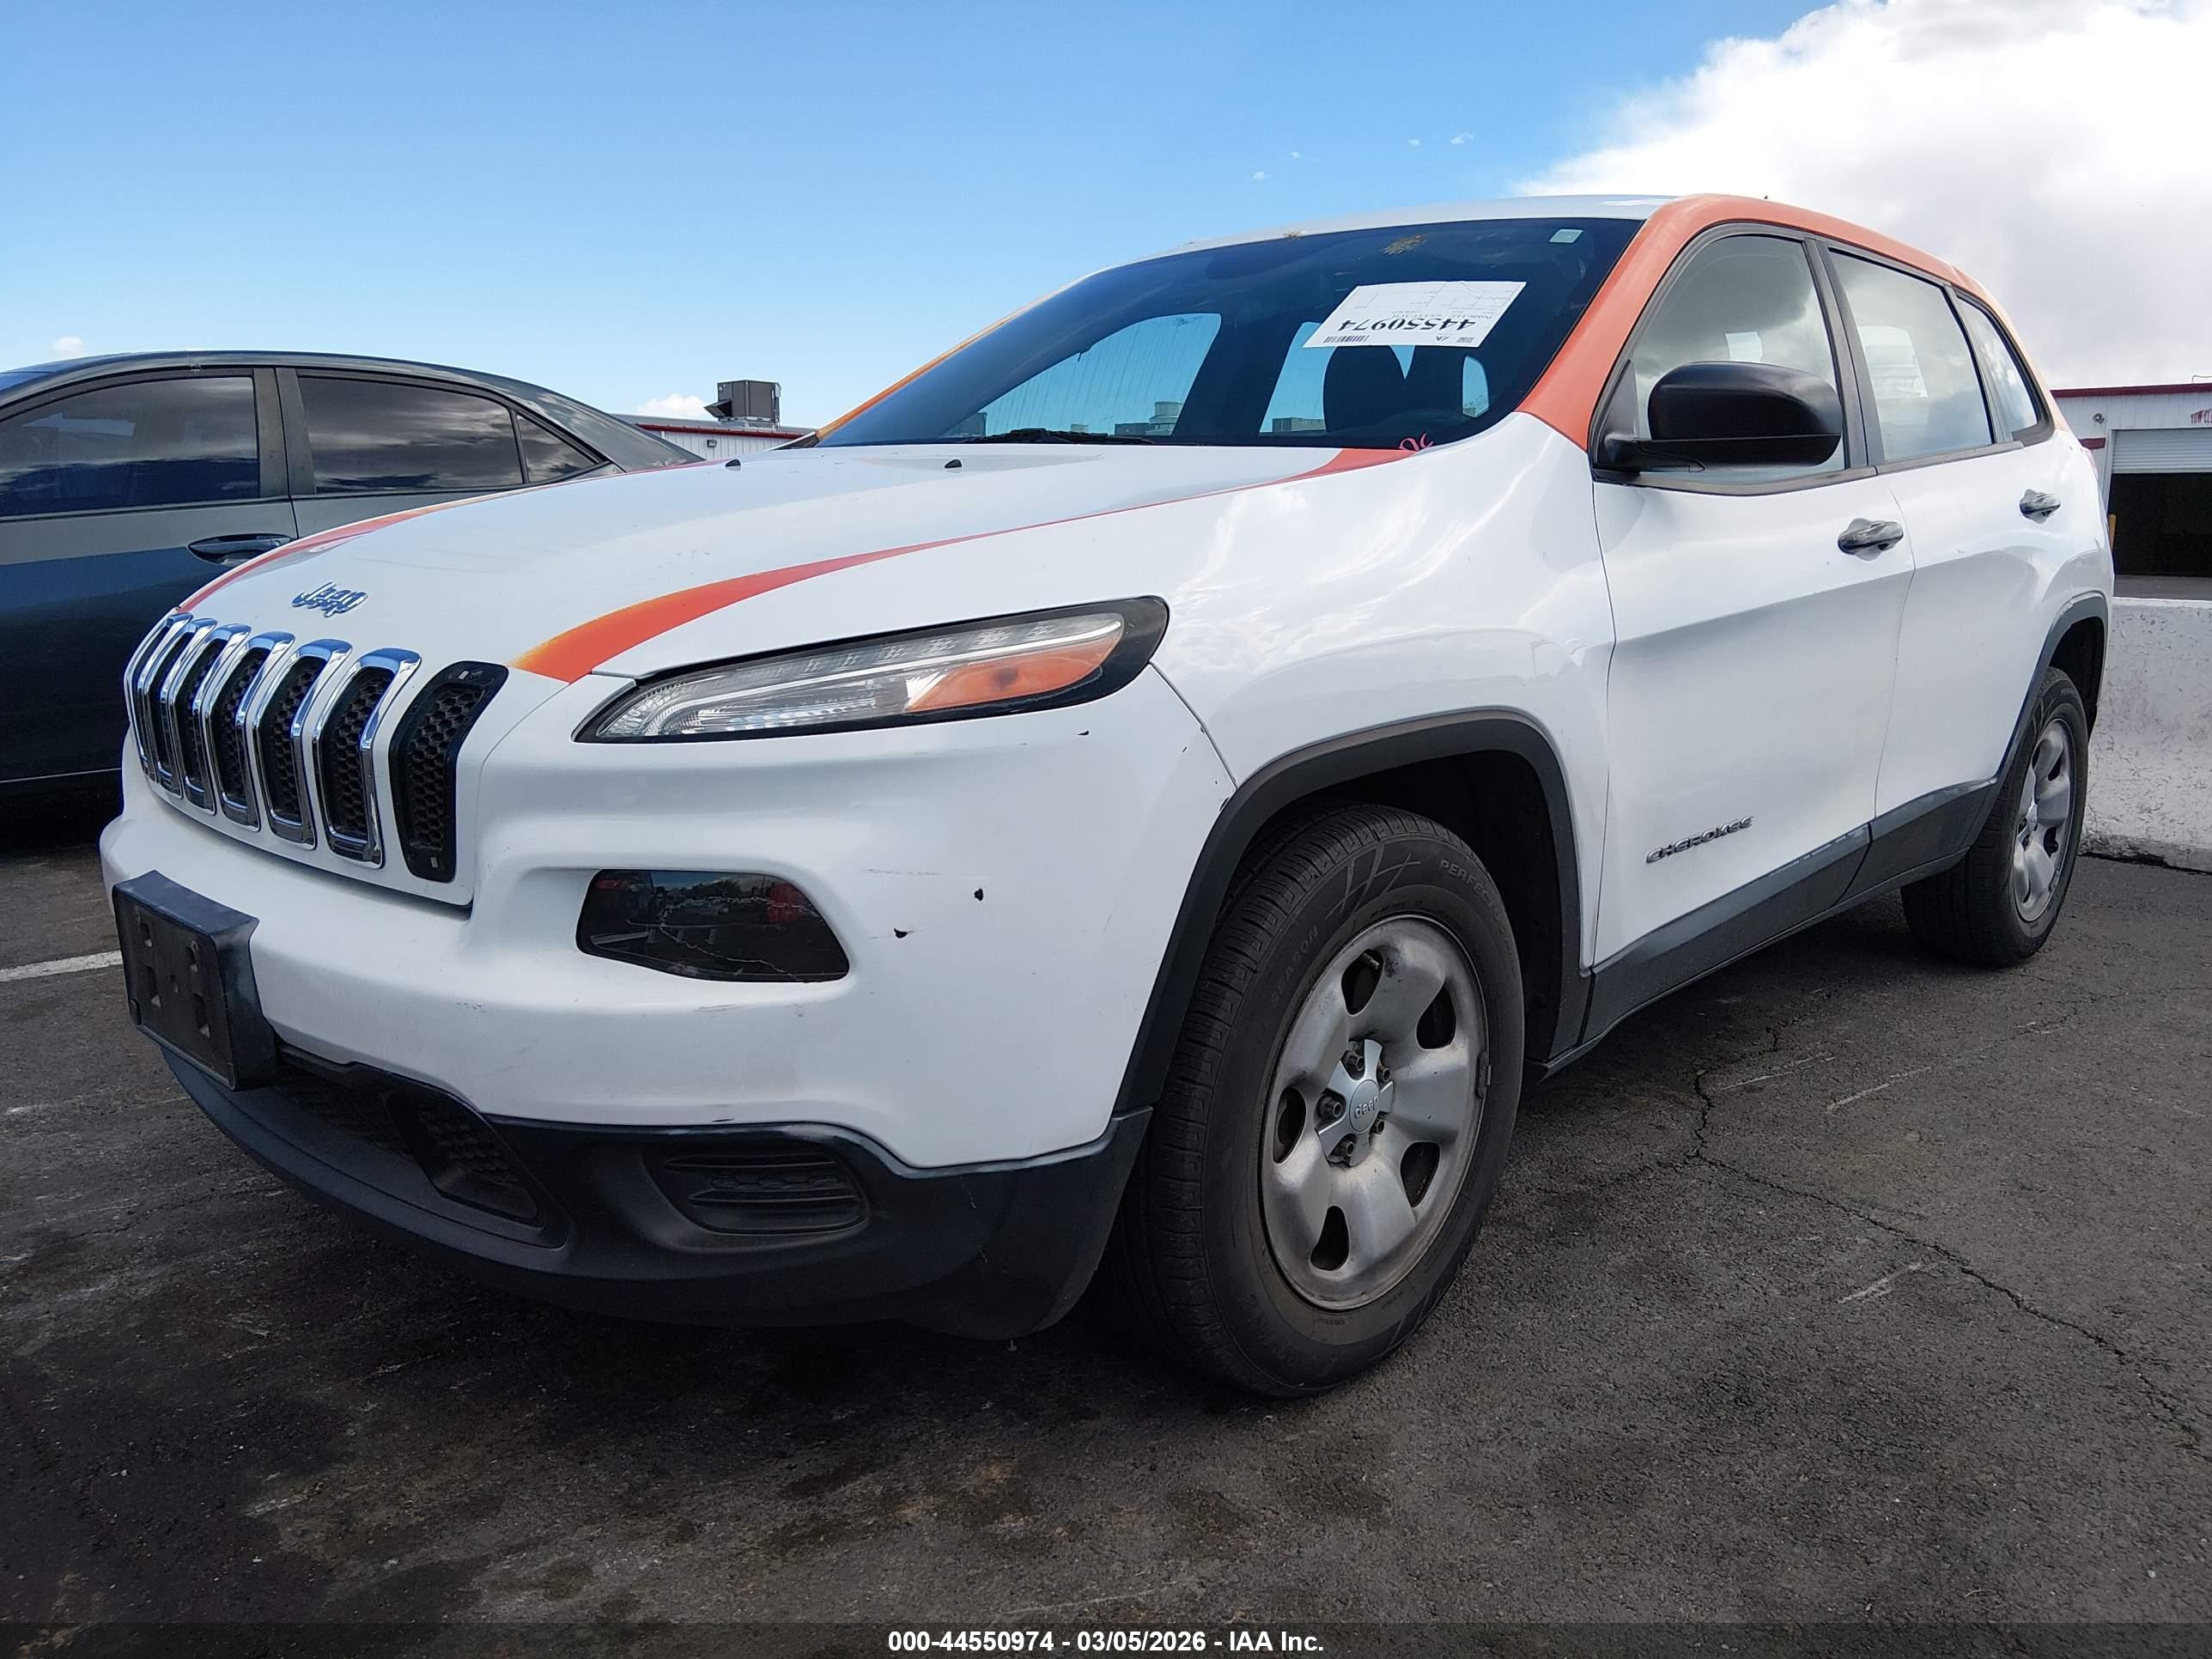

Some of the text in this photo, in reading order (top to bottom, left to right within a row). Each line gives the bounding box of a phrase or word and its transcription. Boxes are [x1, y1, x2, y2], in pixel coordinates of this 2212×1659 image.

[1338, 318, 1476, 331] 44550974
[292, 581, 368, 617] Jeep
[1646, 816, 1753, 864] CHEROKEE
[1354, 1096, 1378, 1119] Jeep
